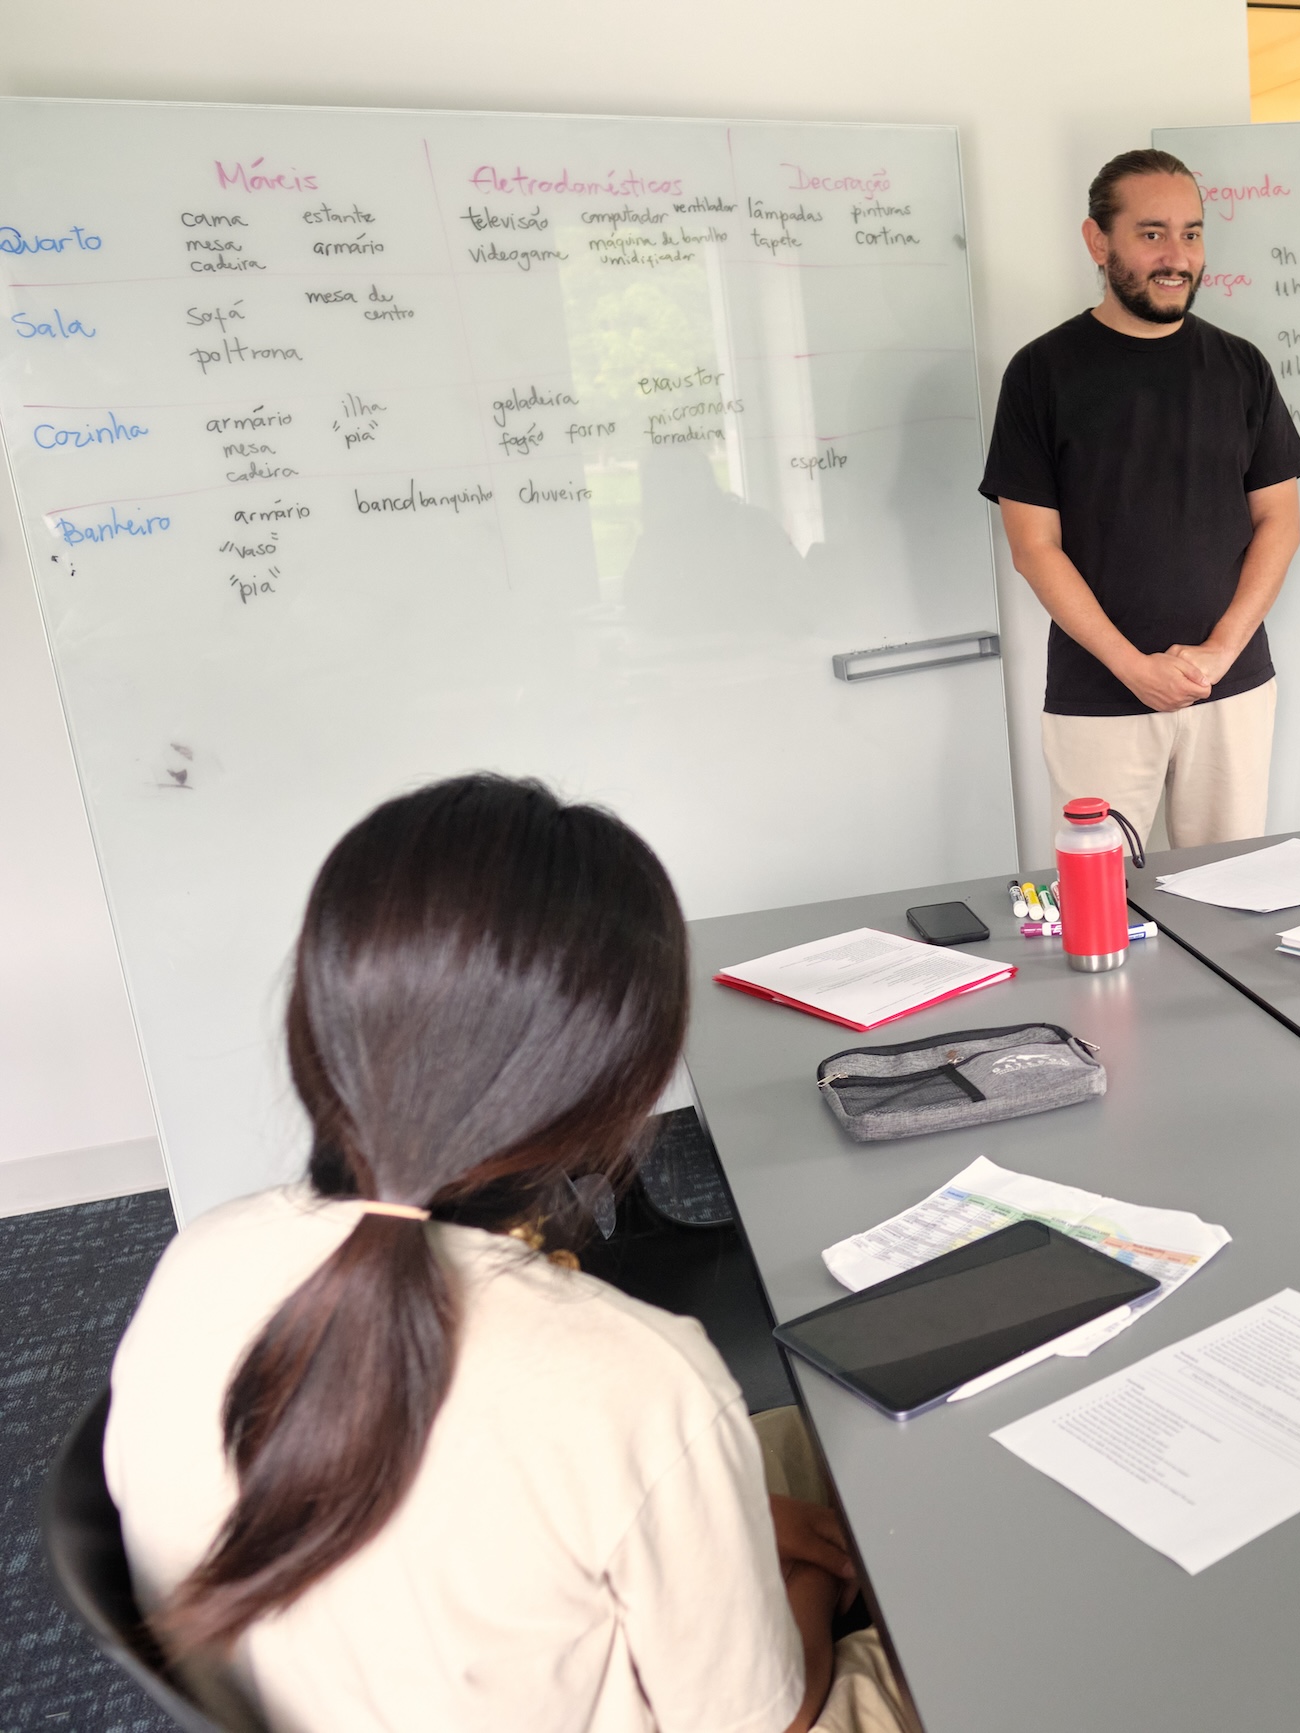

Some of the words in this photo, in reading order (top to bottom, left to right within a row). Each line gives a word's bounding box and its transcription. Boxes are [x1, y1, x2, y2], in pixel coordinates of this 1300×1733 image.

[214, 156, 320, 194] Móveis
[468, 165, 684, 198] Eletrodomésticos
[779, 162, 892, 200] Decoração
[302, 202, 376, 224] estante
[581, 204, 669, 231] computador
[672, 196, 738, 213] ventilador
[748, 196, 823, 230] lâmpadas
[850, 200, 912, 224] pinturas
[181, 212, 249, 227] cama
[459, 206, 549, 231] televisão
[0, 225, 102, 254] Quarto
[186, 238, 242, 252] mesa
[313, 232, 385, 256] armário
[589, 232, 656, 256] máquina
[662, 231, 679, 246] de
[750, 228, 803, 256] tapete
[190, 254, 267, 273] cadeira
[468, 242, 569, 271] videogame
[600, 250, 695, 268] umidificador
[1271, 246, 1297, 265] 9h
[305, 289, 358, 304] mesa
[368, 284, 394, 302] de
[1202, 273, 1252, 297] erça
[11, 309, 96, 338] Sala
[363, 304, 415, 321] centro
[189, 336, 304, 375] poltrona
[638, 366, 725, 395] exaustor
[341, 392, 387, 418] ilha
[493, 385, 579, 428] geladeira
[649, 392, 744, 428] microondas
[34, 411, 149, 449] Cozinha
[206, 405, 293, 434] armário
[565, 422, 617, 444] forno
[643, 425, 726, 445] torradeira
[223, 442, 276, 458] mesa
[225, 462, 300, 484] cadeira
[790, 447, 848, 480] espelho
[233, 499, 311, 525] armário
[56, 506, 171, 546] Banheiro
